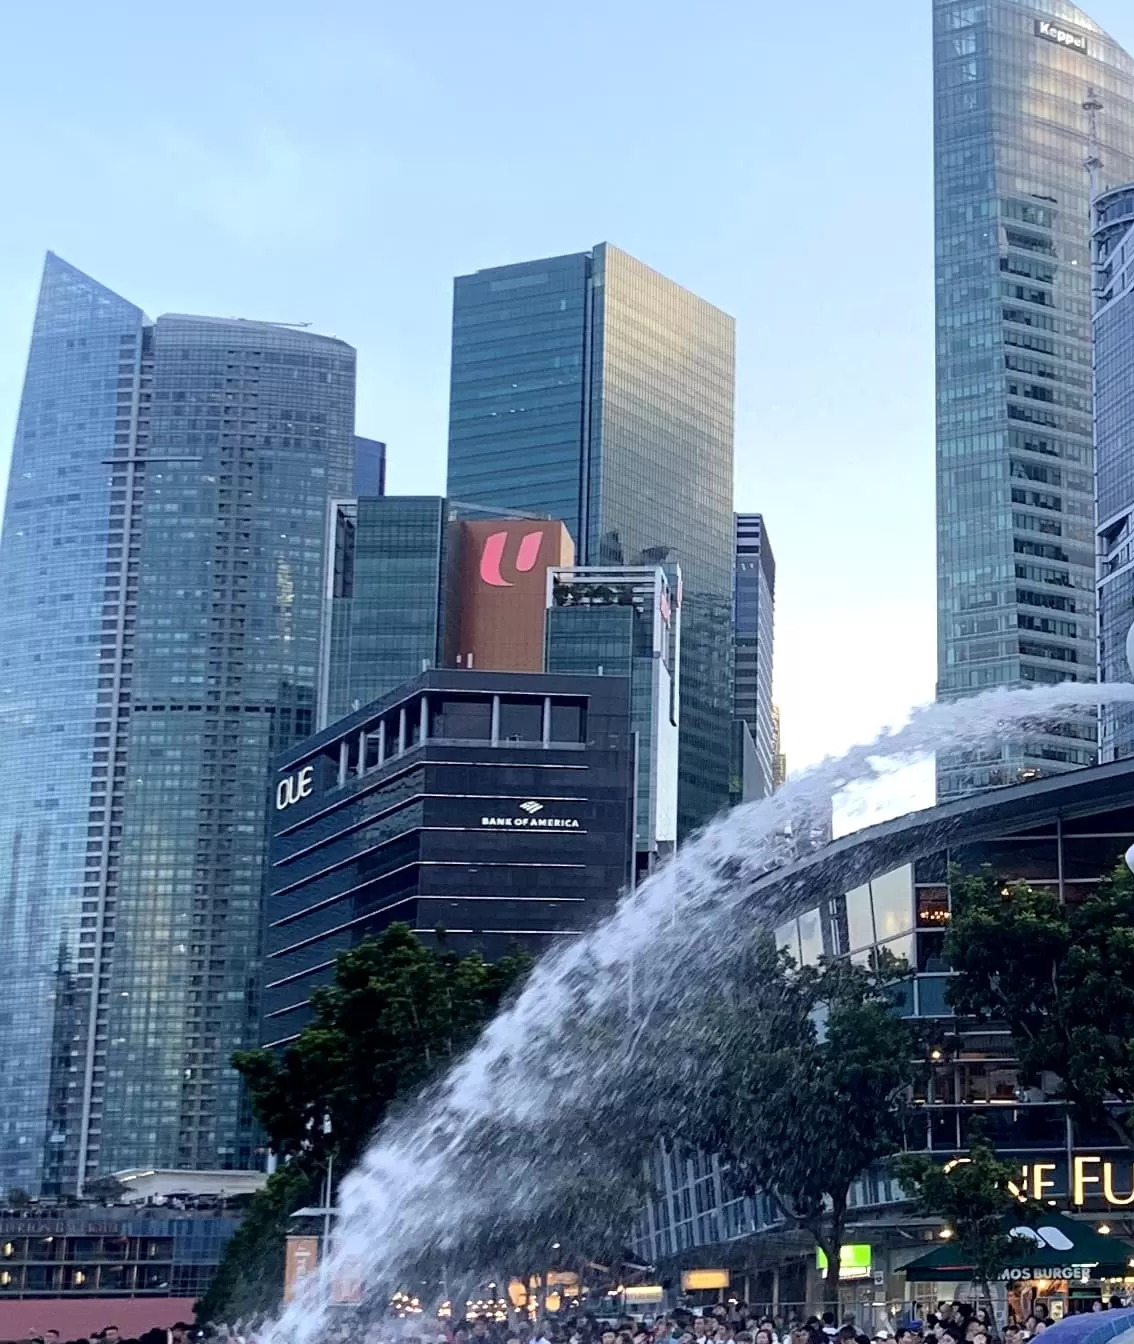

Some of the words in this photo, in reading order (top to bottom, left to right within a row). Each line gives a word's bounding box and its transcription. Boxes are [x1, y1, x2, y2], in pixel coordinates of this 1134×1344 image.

[1040, 21, 1086, 49] Keppel
[276, 766, 314, 810] OUE
[481, 817, 512, 826] BANK
[514, 818, 528, 826] OF
[530, 818, 580, 828] AMERICA
[997, 1267, 1031, 1280] MOS
[1033, 1266, 1091, 1281] BURGER
